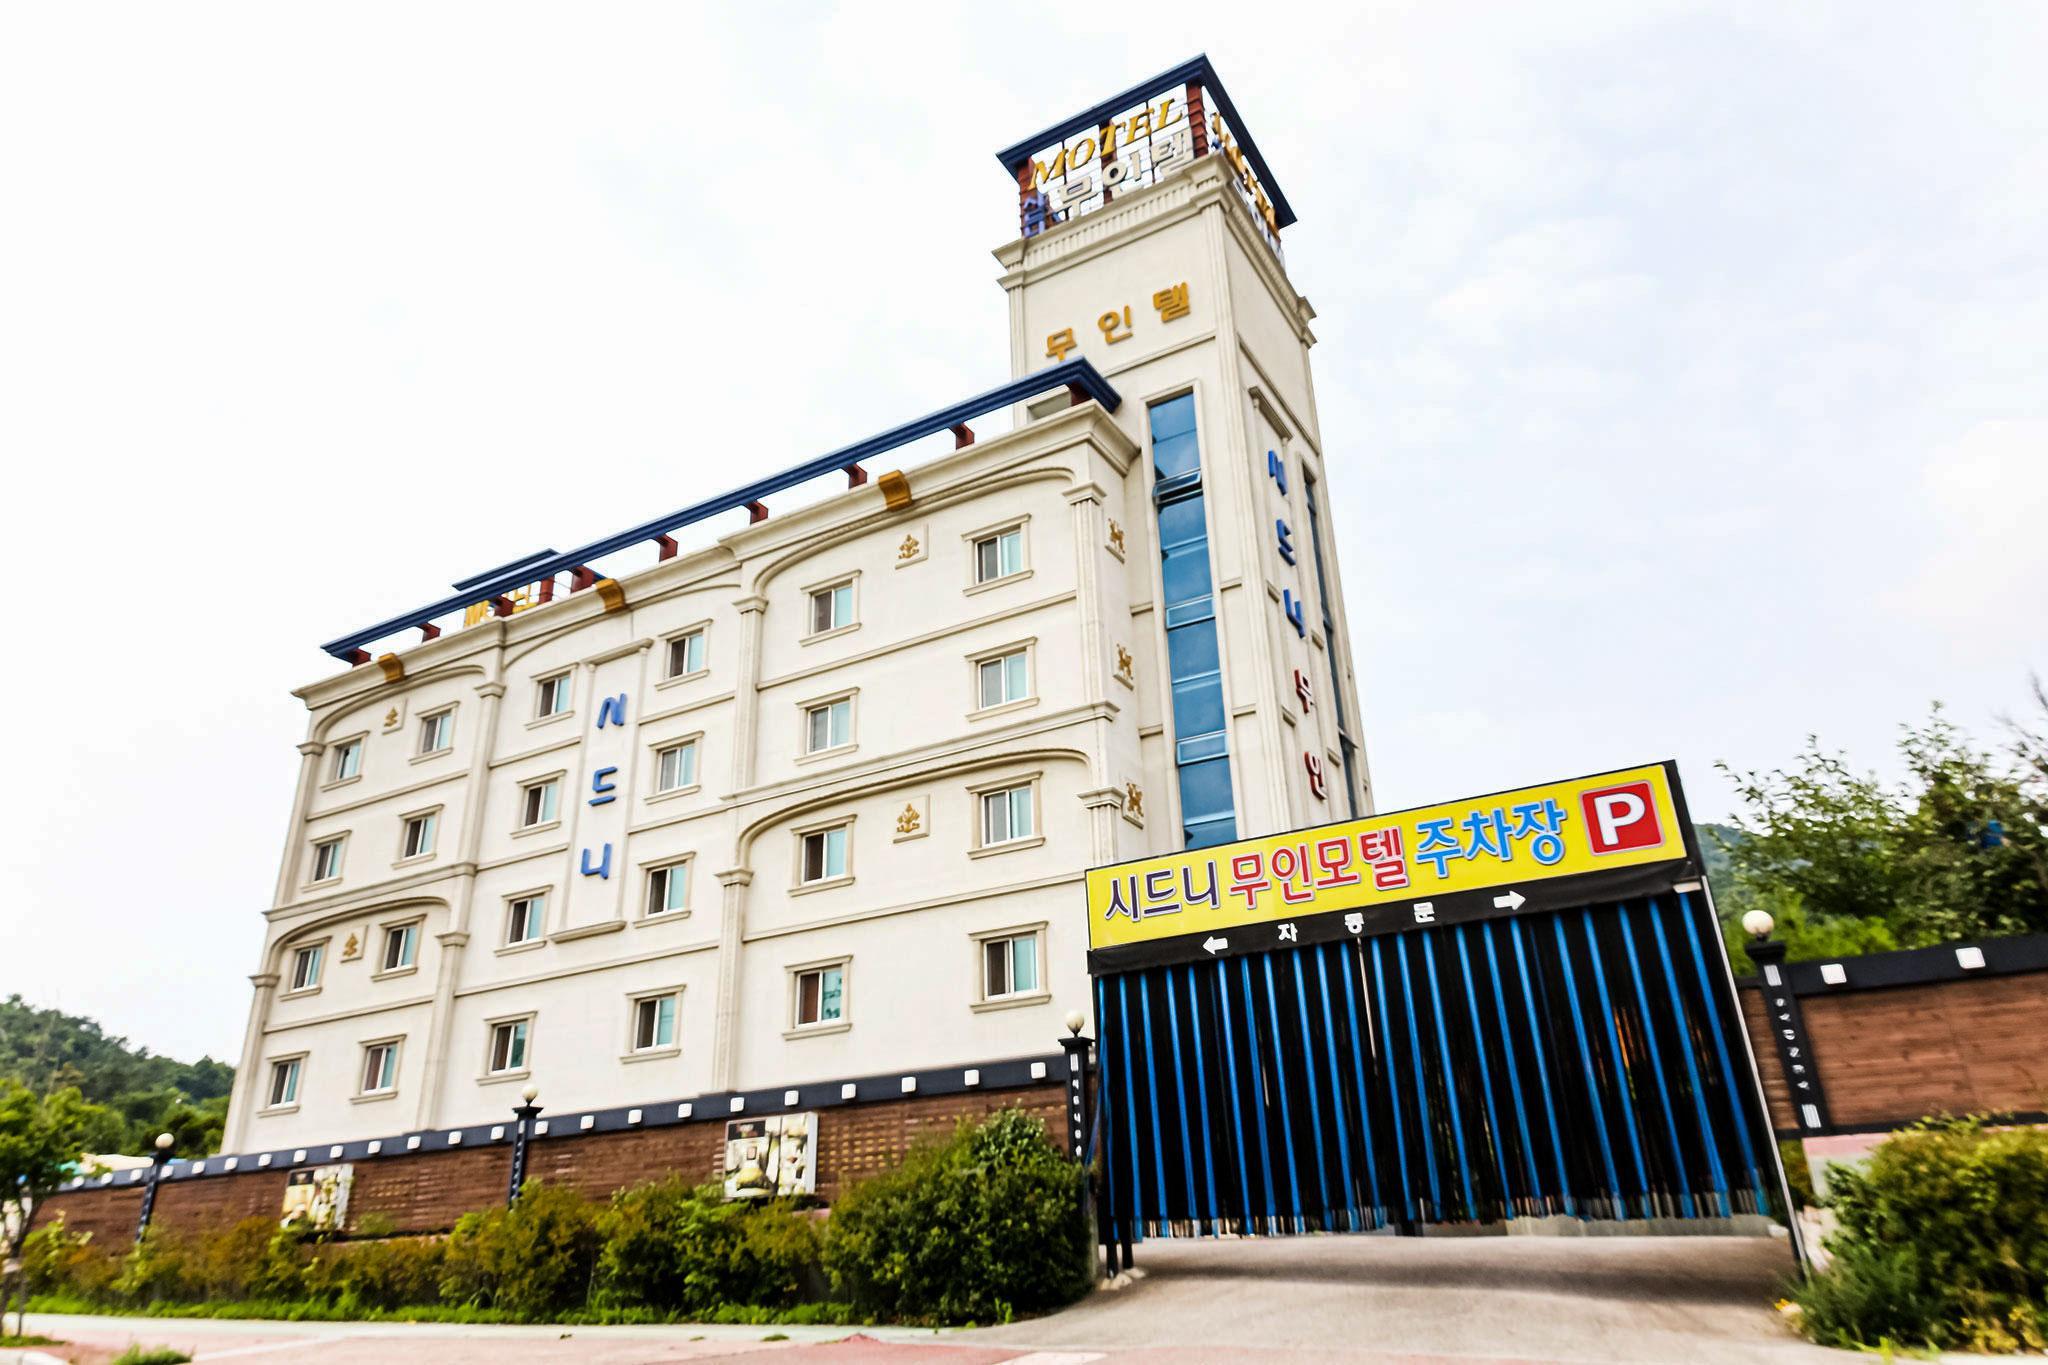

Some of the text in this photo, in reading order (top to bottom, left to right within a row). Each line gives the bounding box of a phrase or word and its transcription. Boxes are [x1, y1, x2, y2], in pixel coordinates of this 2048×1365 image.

[1028, 97, 1184, 191] MOTEL
[580, 692, 628, 880] 시드니
[1104, 791, 1647, 923] 시드니 무인모텔 주차장 P
[1277, 901, 1435, 942] 자동문
